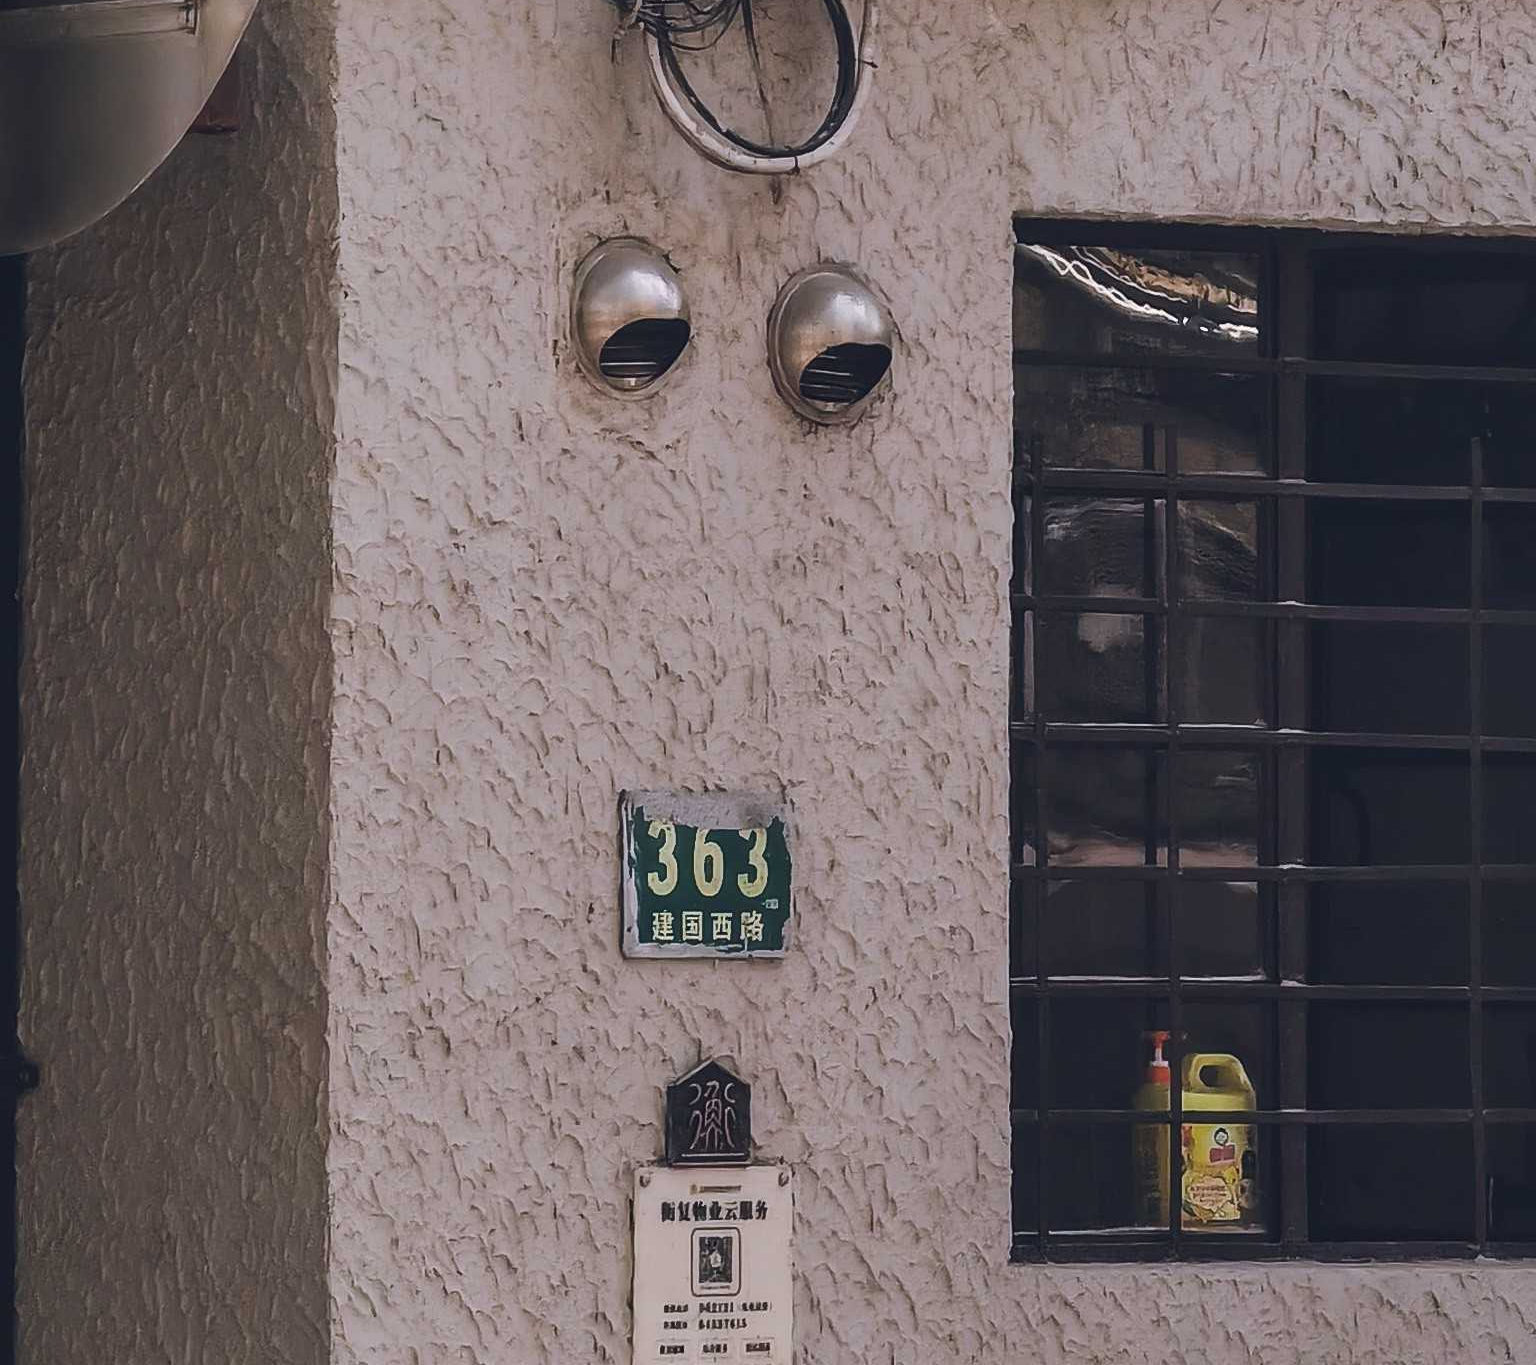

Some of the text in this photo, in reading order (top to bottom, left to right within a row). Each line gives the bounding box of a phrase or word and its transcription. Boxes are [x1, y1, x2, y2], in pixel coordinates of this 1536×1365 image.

[647, 820, 769, 898] 363
[652, 910, 764, 942] 建国西路
